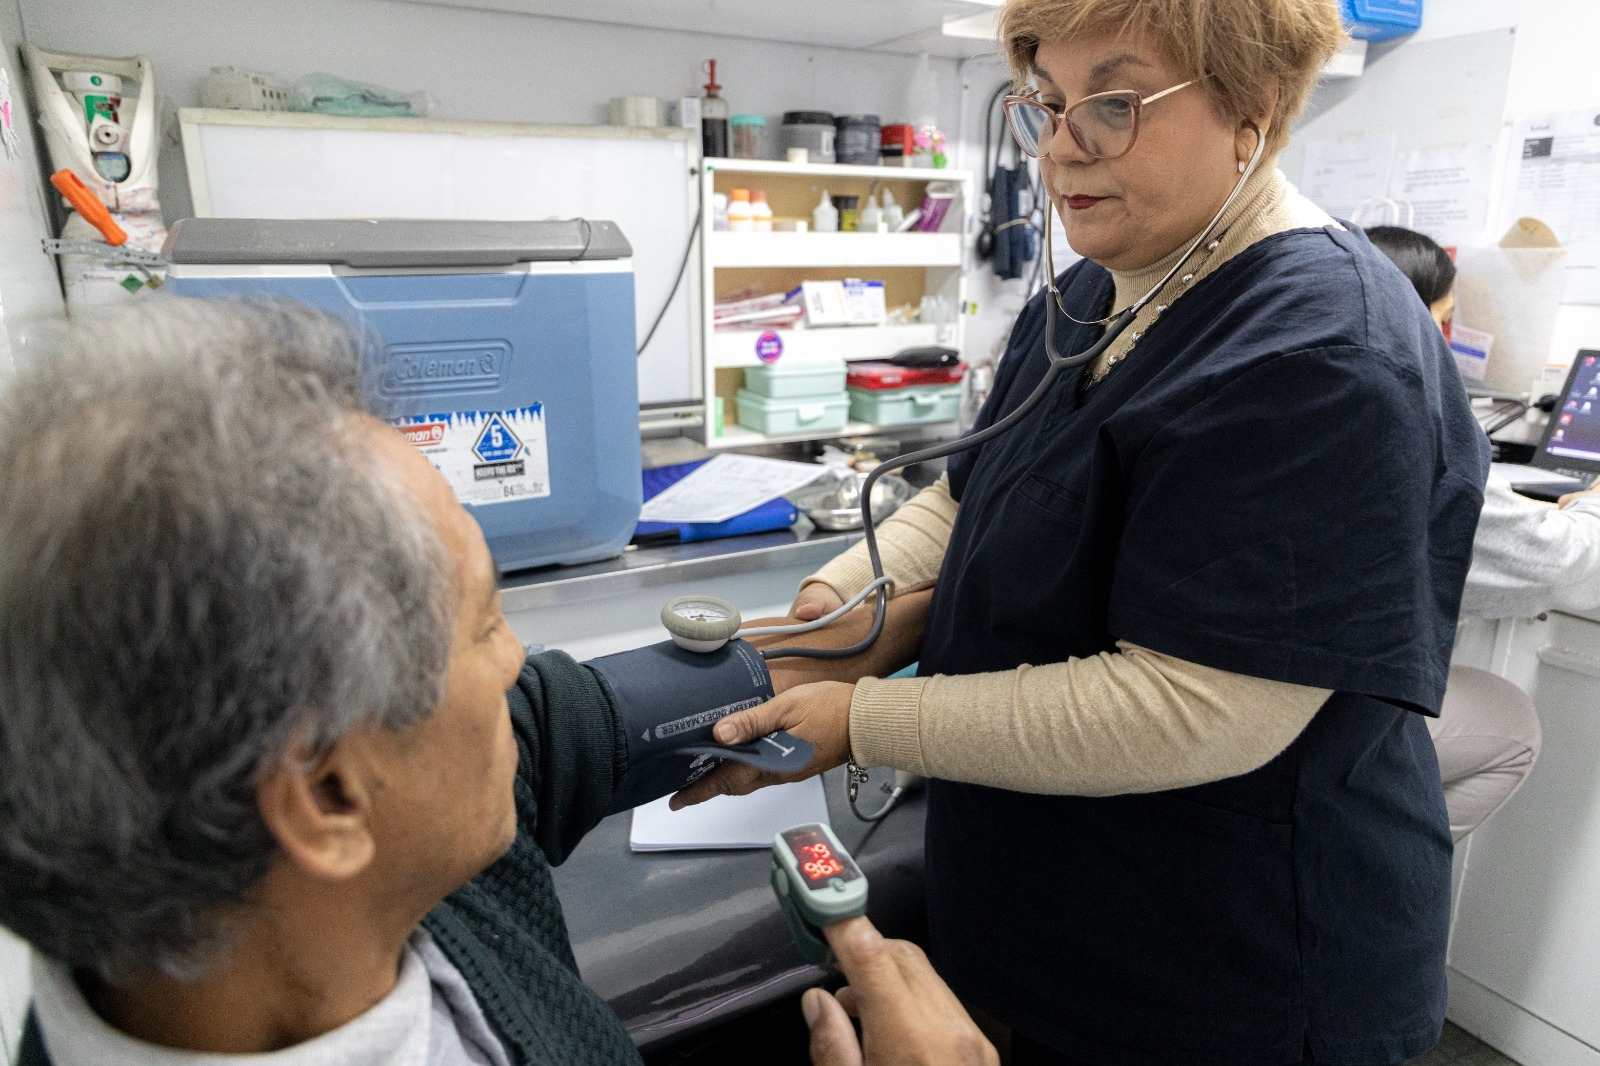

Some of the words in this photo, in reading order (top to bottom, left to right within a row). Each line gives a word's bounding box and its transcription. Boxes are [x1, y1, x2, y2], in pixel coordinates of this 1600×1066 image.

[394, 353, 476, 381] Coleman
[491, 424, 503, 447] 5
[662, 717, 699, 735] MARKER
[701, 710, 726, 722] INDEX
